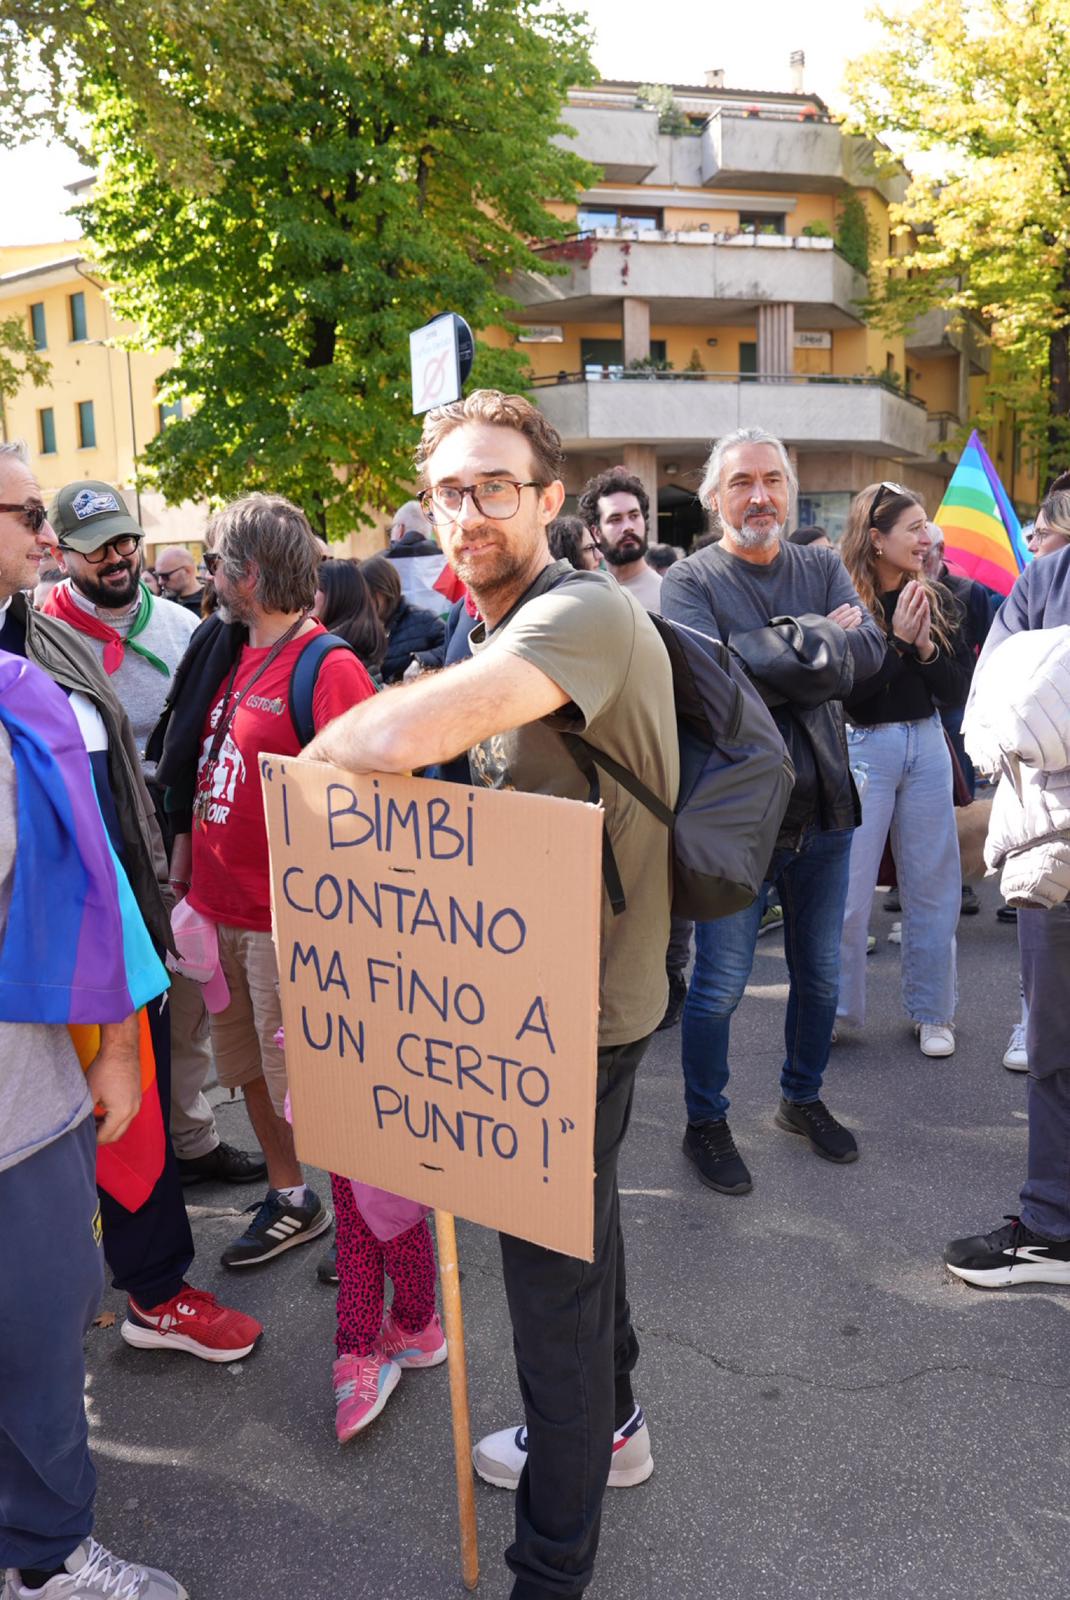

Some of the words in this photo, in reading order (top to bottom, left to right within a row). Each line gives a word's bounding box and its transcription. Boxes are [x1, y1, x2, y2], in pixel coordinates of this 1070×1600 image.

[282, 866, 527, 955] CONTANO
[290, 941, 351, 999] MA
[515, 996, 556, 1054] A
[302, 1006, 364, 1063] UN
[397, 1033, 550, 1108] CERTO
